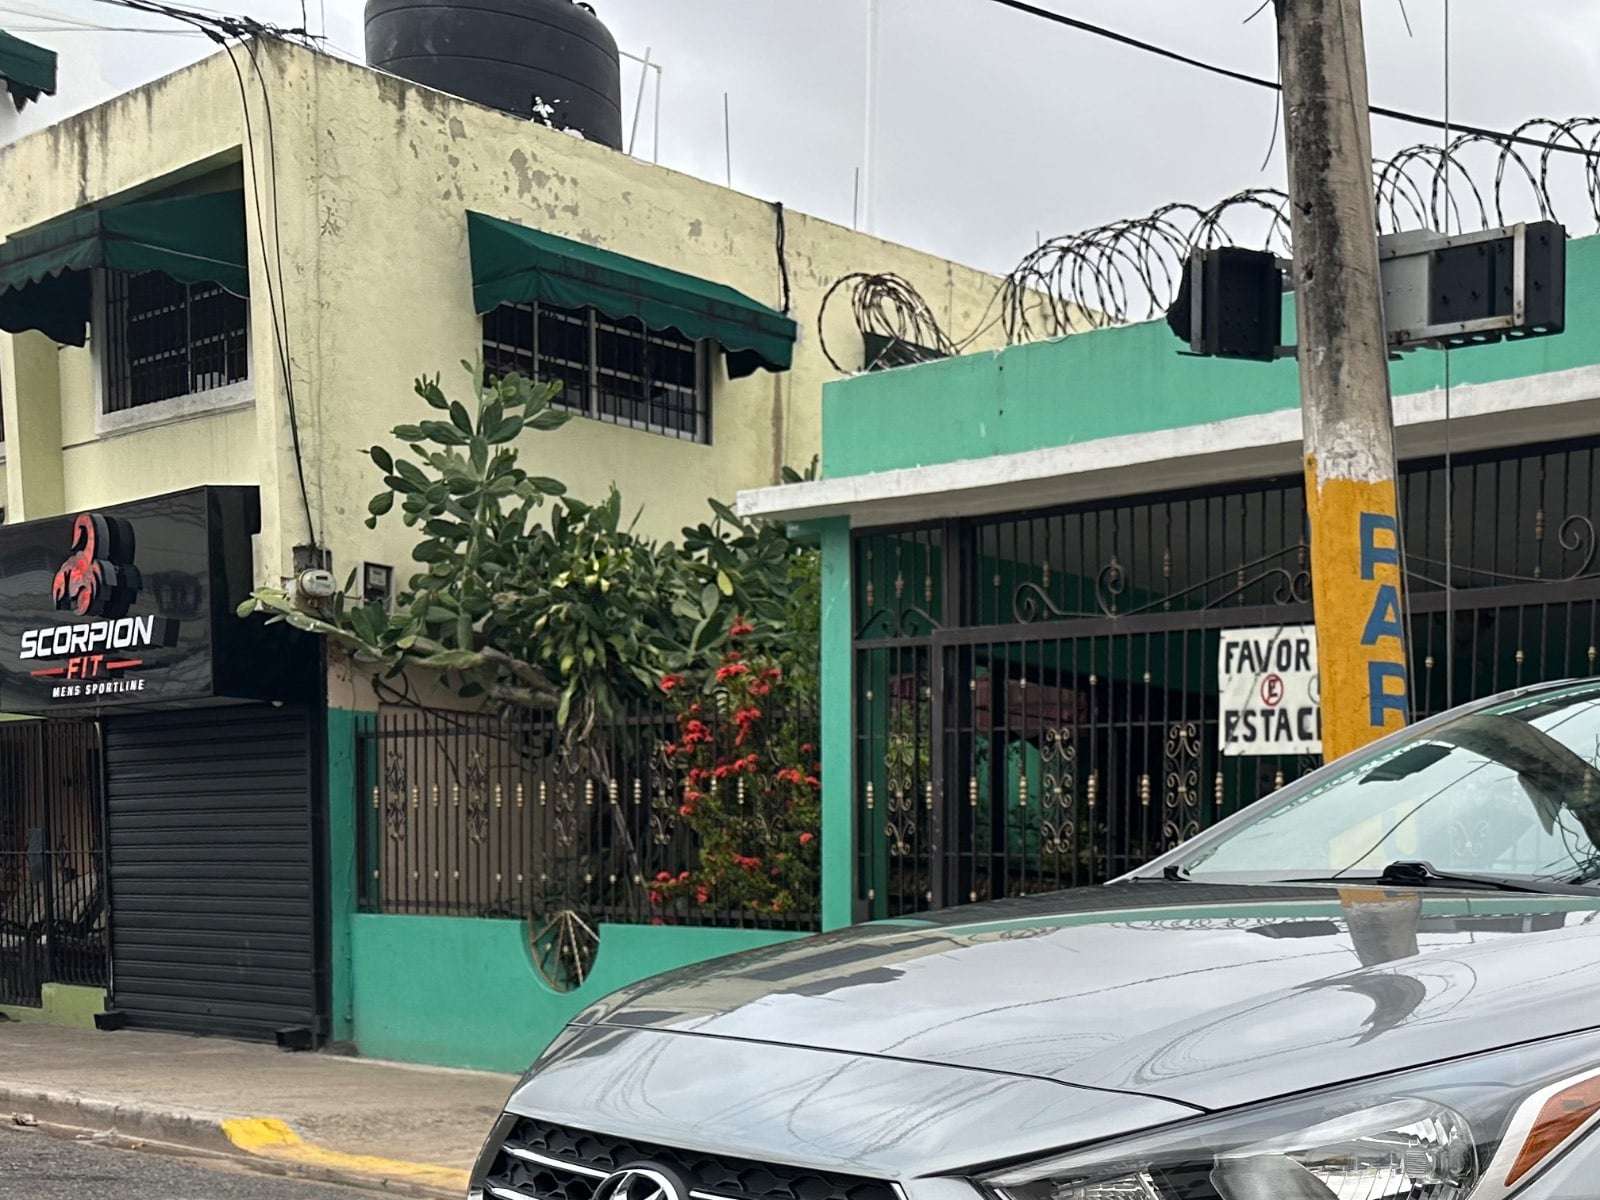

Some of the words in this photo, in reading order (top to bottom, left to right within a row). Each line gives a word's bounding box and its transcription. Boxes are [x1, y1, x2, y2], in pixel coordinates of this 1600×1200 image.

[20, 615, 154, 659] SCORPION
[67, 655, 104, 679] FIT
[1225, 639, 1310, 674] FAVOR
[52, 685, 82, 698] MENS
[85, 679, 145, 696] SPORTLINE
